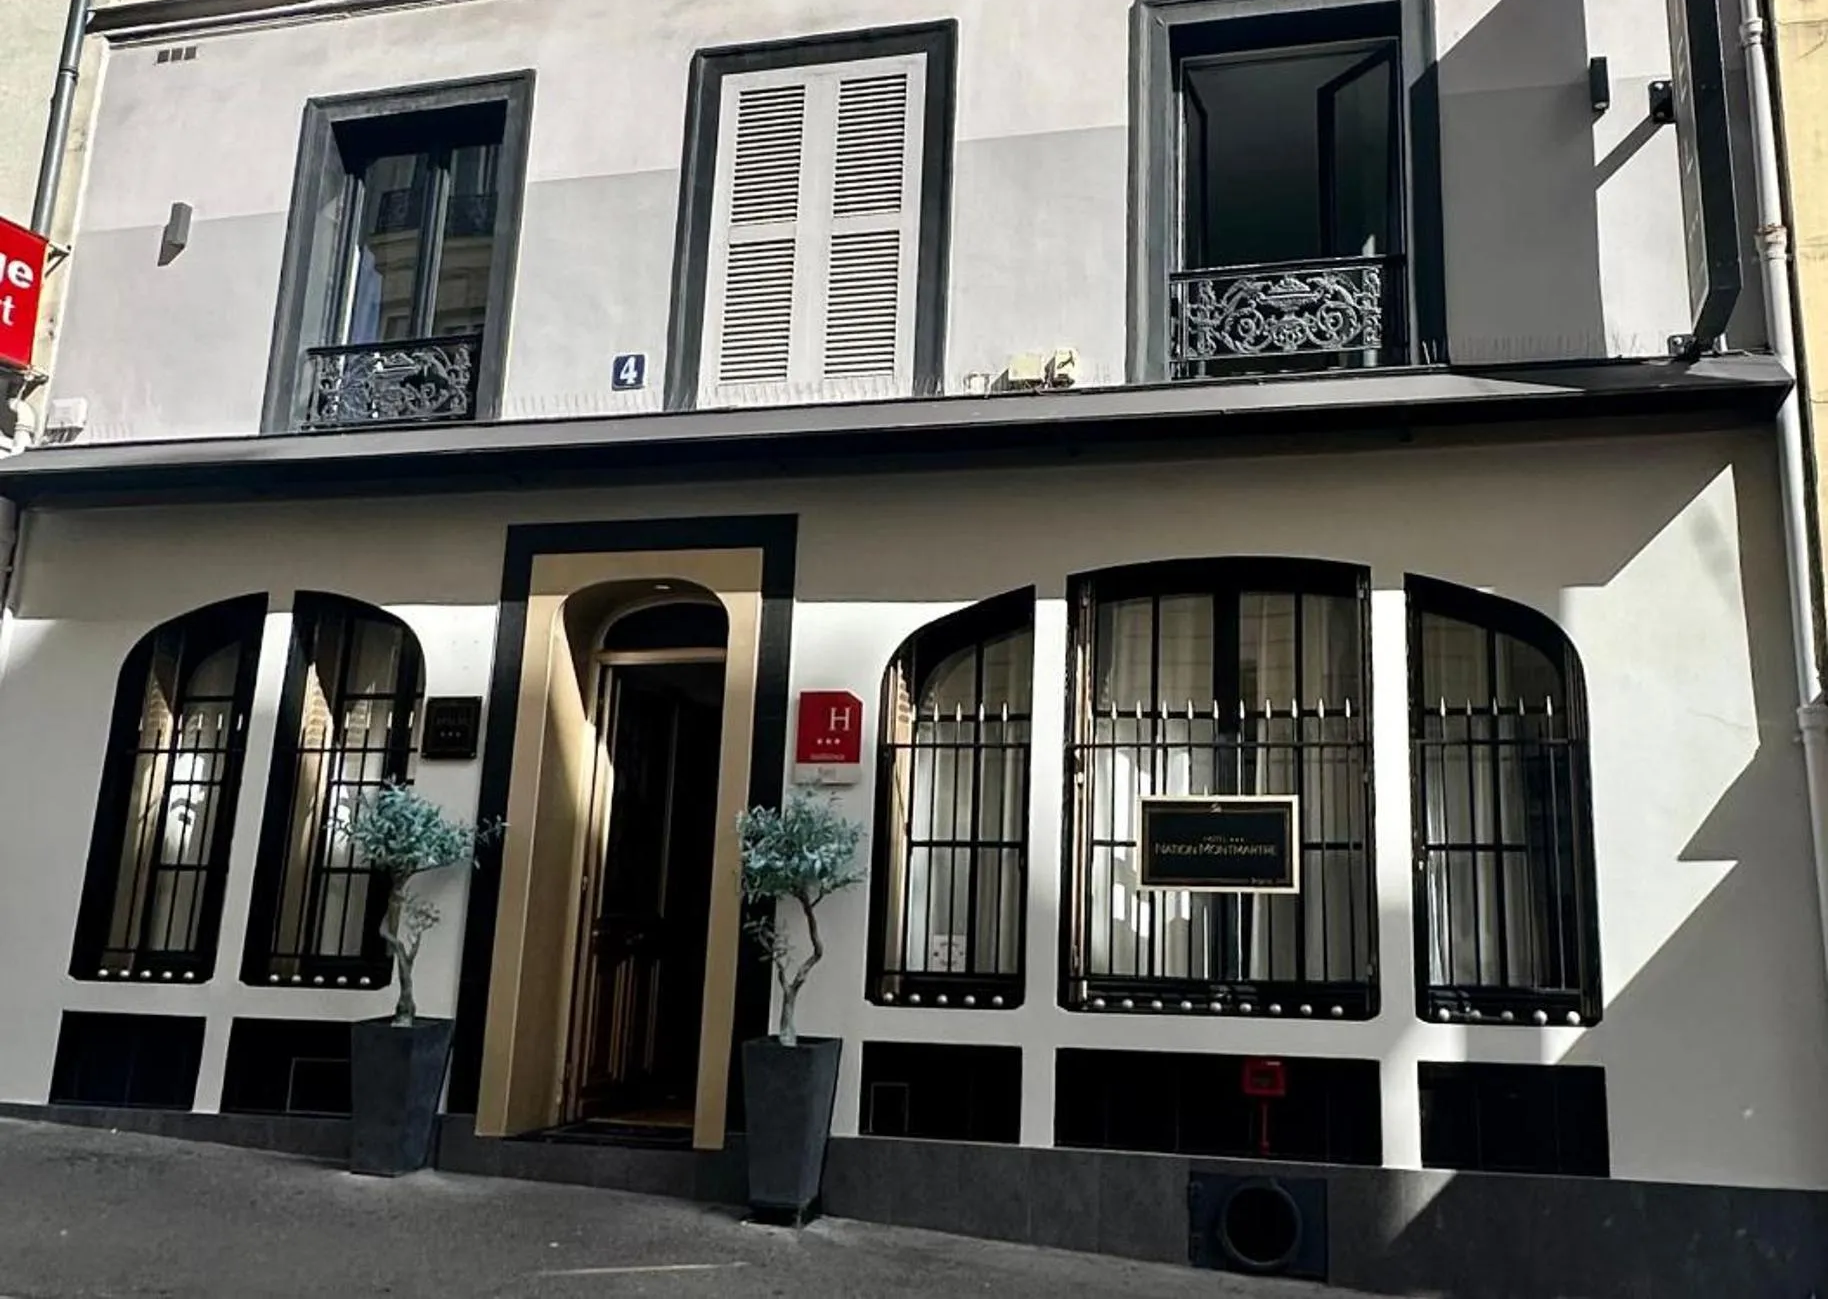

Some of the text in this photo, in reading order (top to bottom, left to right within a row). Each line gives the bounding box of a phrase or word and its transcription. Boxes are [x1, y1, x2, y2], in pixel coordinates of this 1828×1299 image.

[0, 295, 16, 327] t
[620, 356, 638, 384] 4
[828, 706, 851, 732] H
